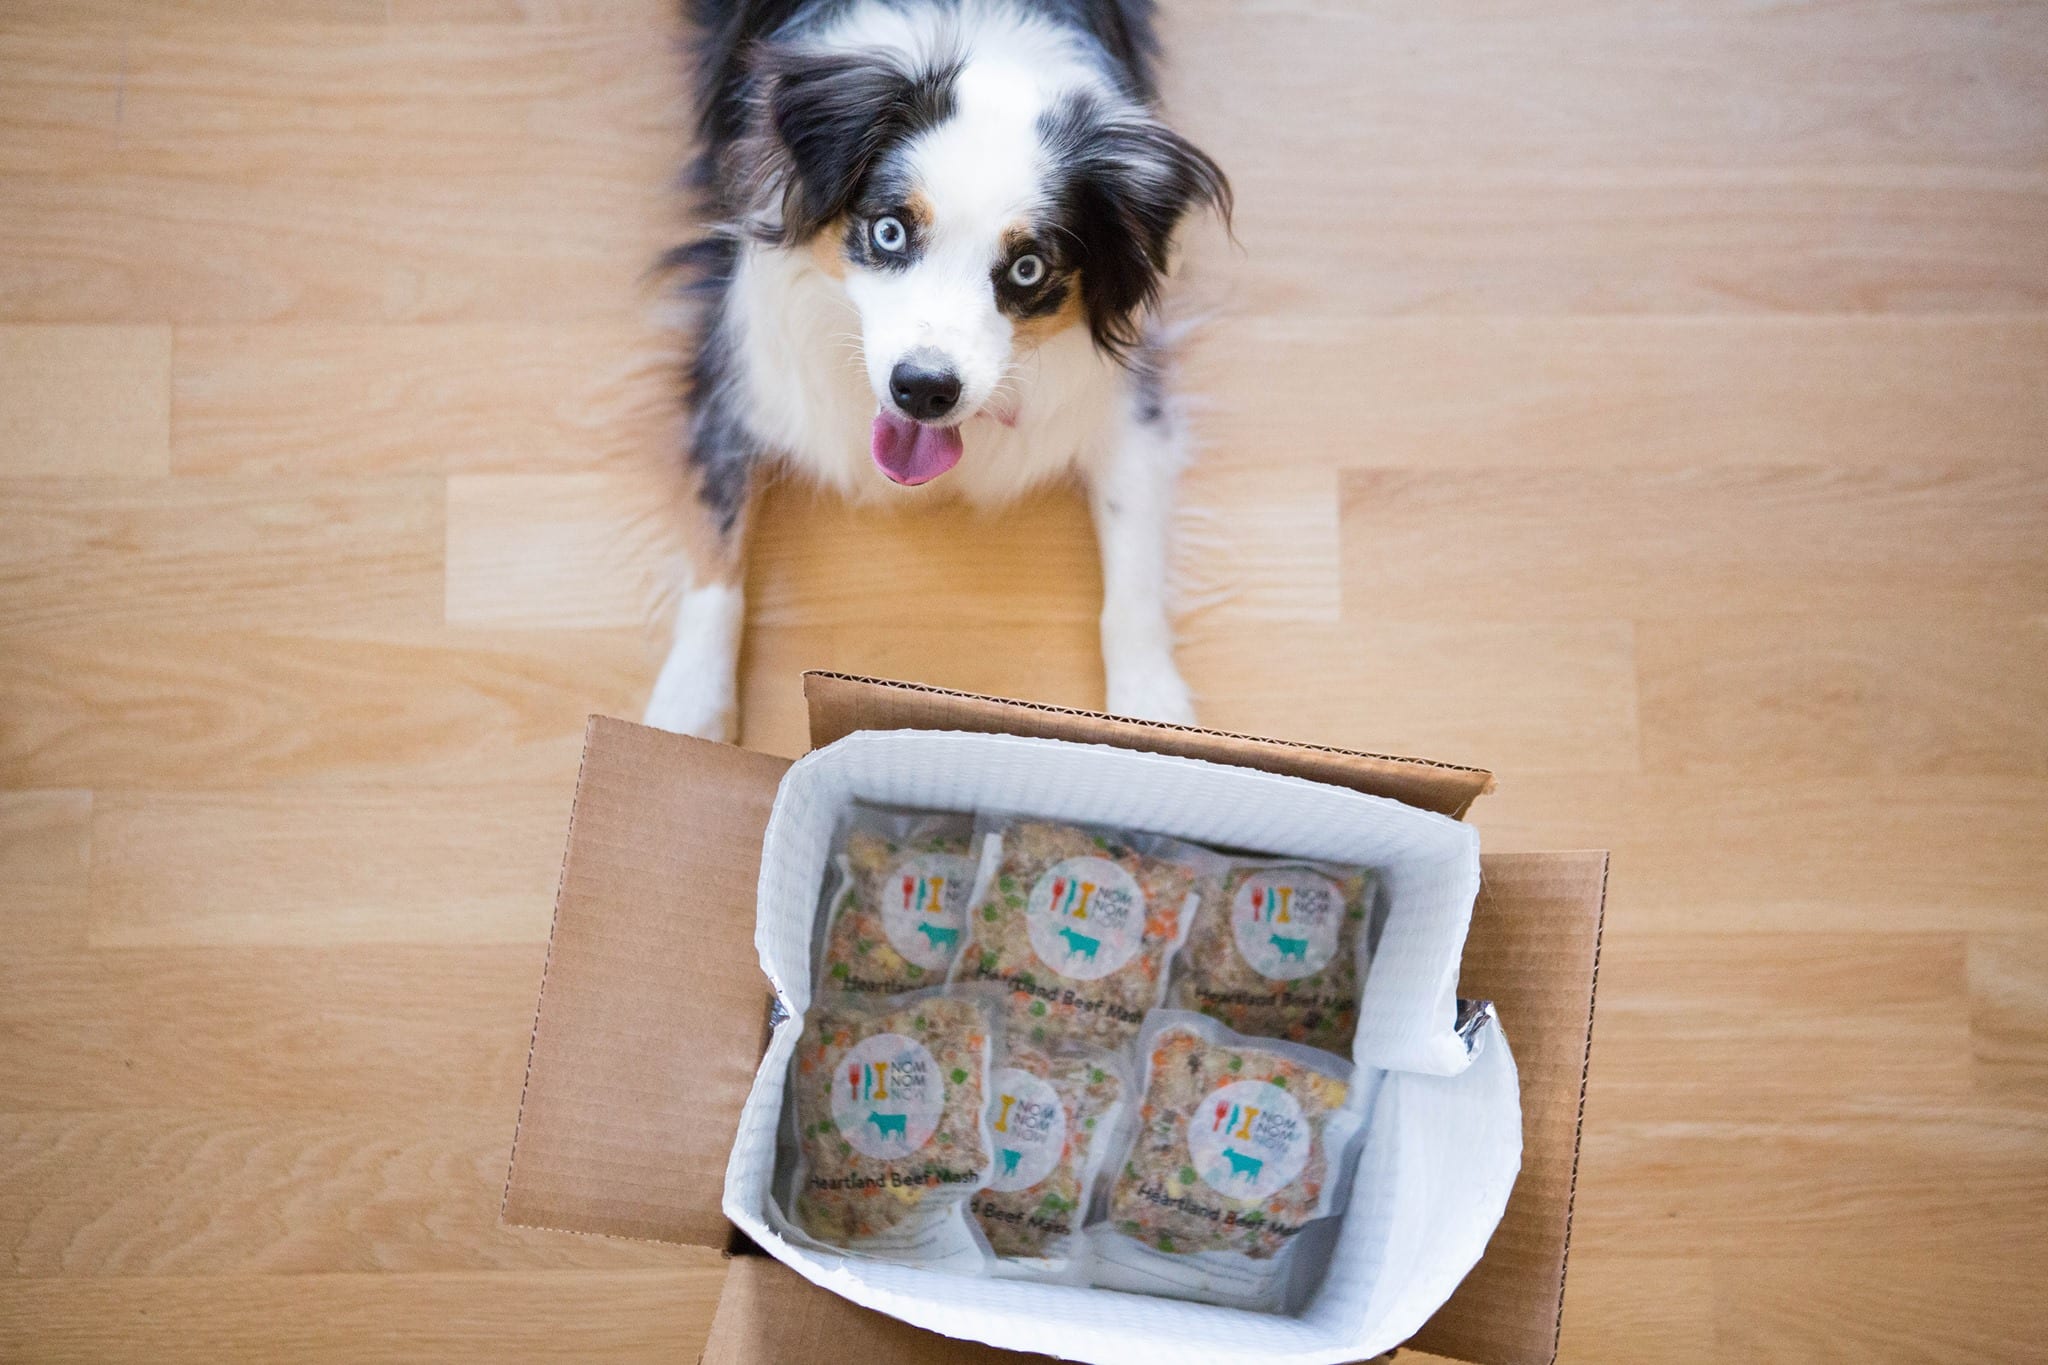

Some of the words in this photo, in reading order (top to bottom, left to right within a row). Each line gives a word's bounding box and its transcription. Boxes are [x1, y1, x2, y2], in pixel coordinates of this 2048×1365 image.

[1294, 888, 1330, 900] NOM
[1094, 900, 1129, 918] NOM
[1294, 901, 1329, 914] NOM
[1062, 989, 1105, 1013] Beef
[890, 1061, 927, 1073] NOM
[890, 1074, 927, 1087] NOM
[1261, 1111, 1297, 1129] NOM
[1256, 1122, 1295, 1140] NOM
[810, 1172, 886, 1190] Heartland
[891, 1172, 930, 1187] Beef
[936, 1168, 980, 1183] Mash
[983, 1202, 1025, 1223] Beef
[1137, 1183, 1221, 1221] Heartland
[1224, 1210, 1266, 1229] Beef
